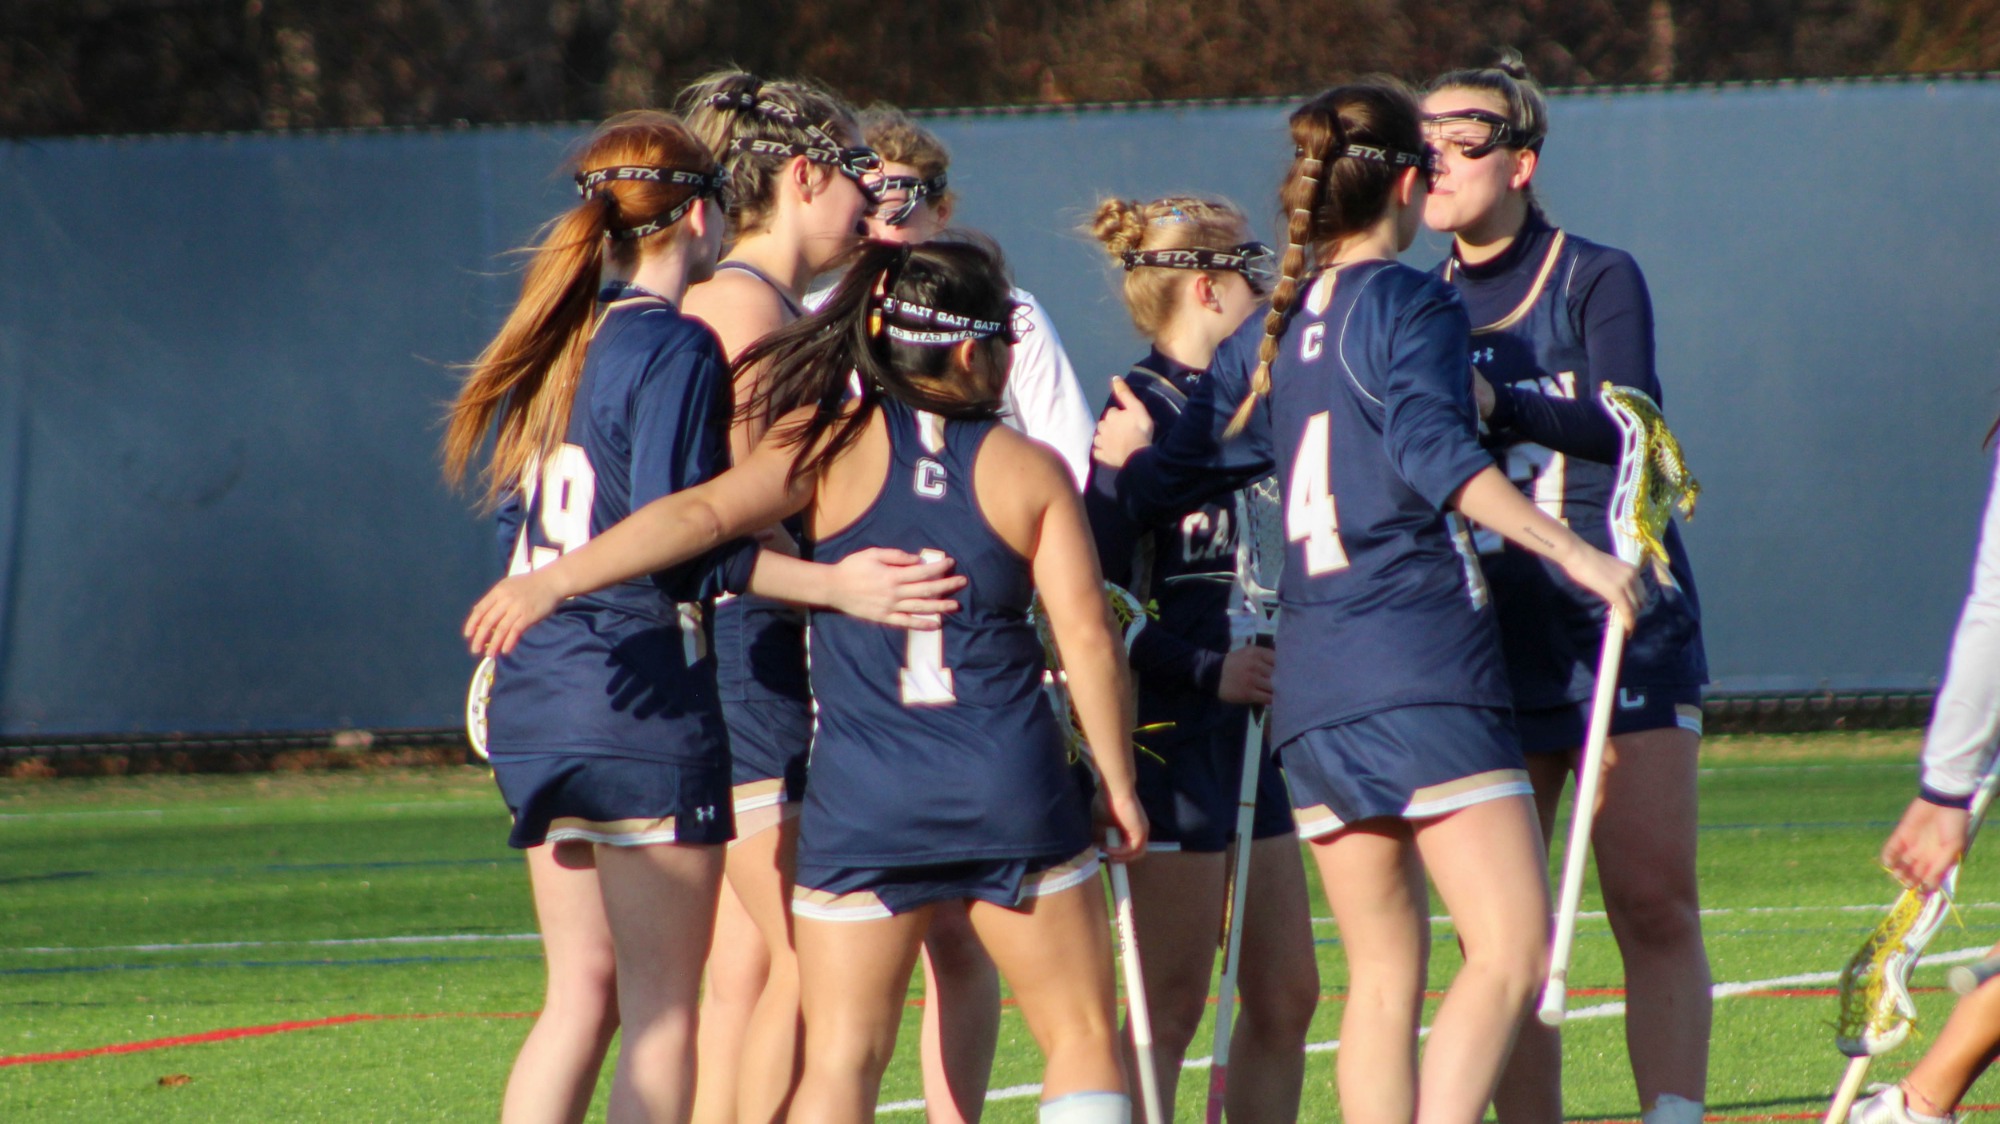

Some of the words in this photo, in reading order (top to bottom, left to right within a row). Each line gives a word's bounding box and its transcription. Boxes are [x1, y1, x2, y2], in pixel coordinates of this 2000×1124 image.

[758, 100, 798, 123] STX
[751, 139, 793, 156] STX
[1346, 143, 1386, 160] STX
[617, 167, 661, 181] STX
[672, 171, 705, 185] STX
[1156, 250, 1199, 263] STX
[1211, 253, 1244, 265] ST
[901, 301, 933, 318] GAIT
[936, 311, 970, 328] GAIT
[973, 319, 1001, 332] GAIT
[1301, 321, 1326, 362] C
[914, 456, 947, 498] C
[1286, 410, 1350, 577] 4
